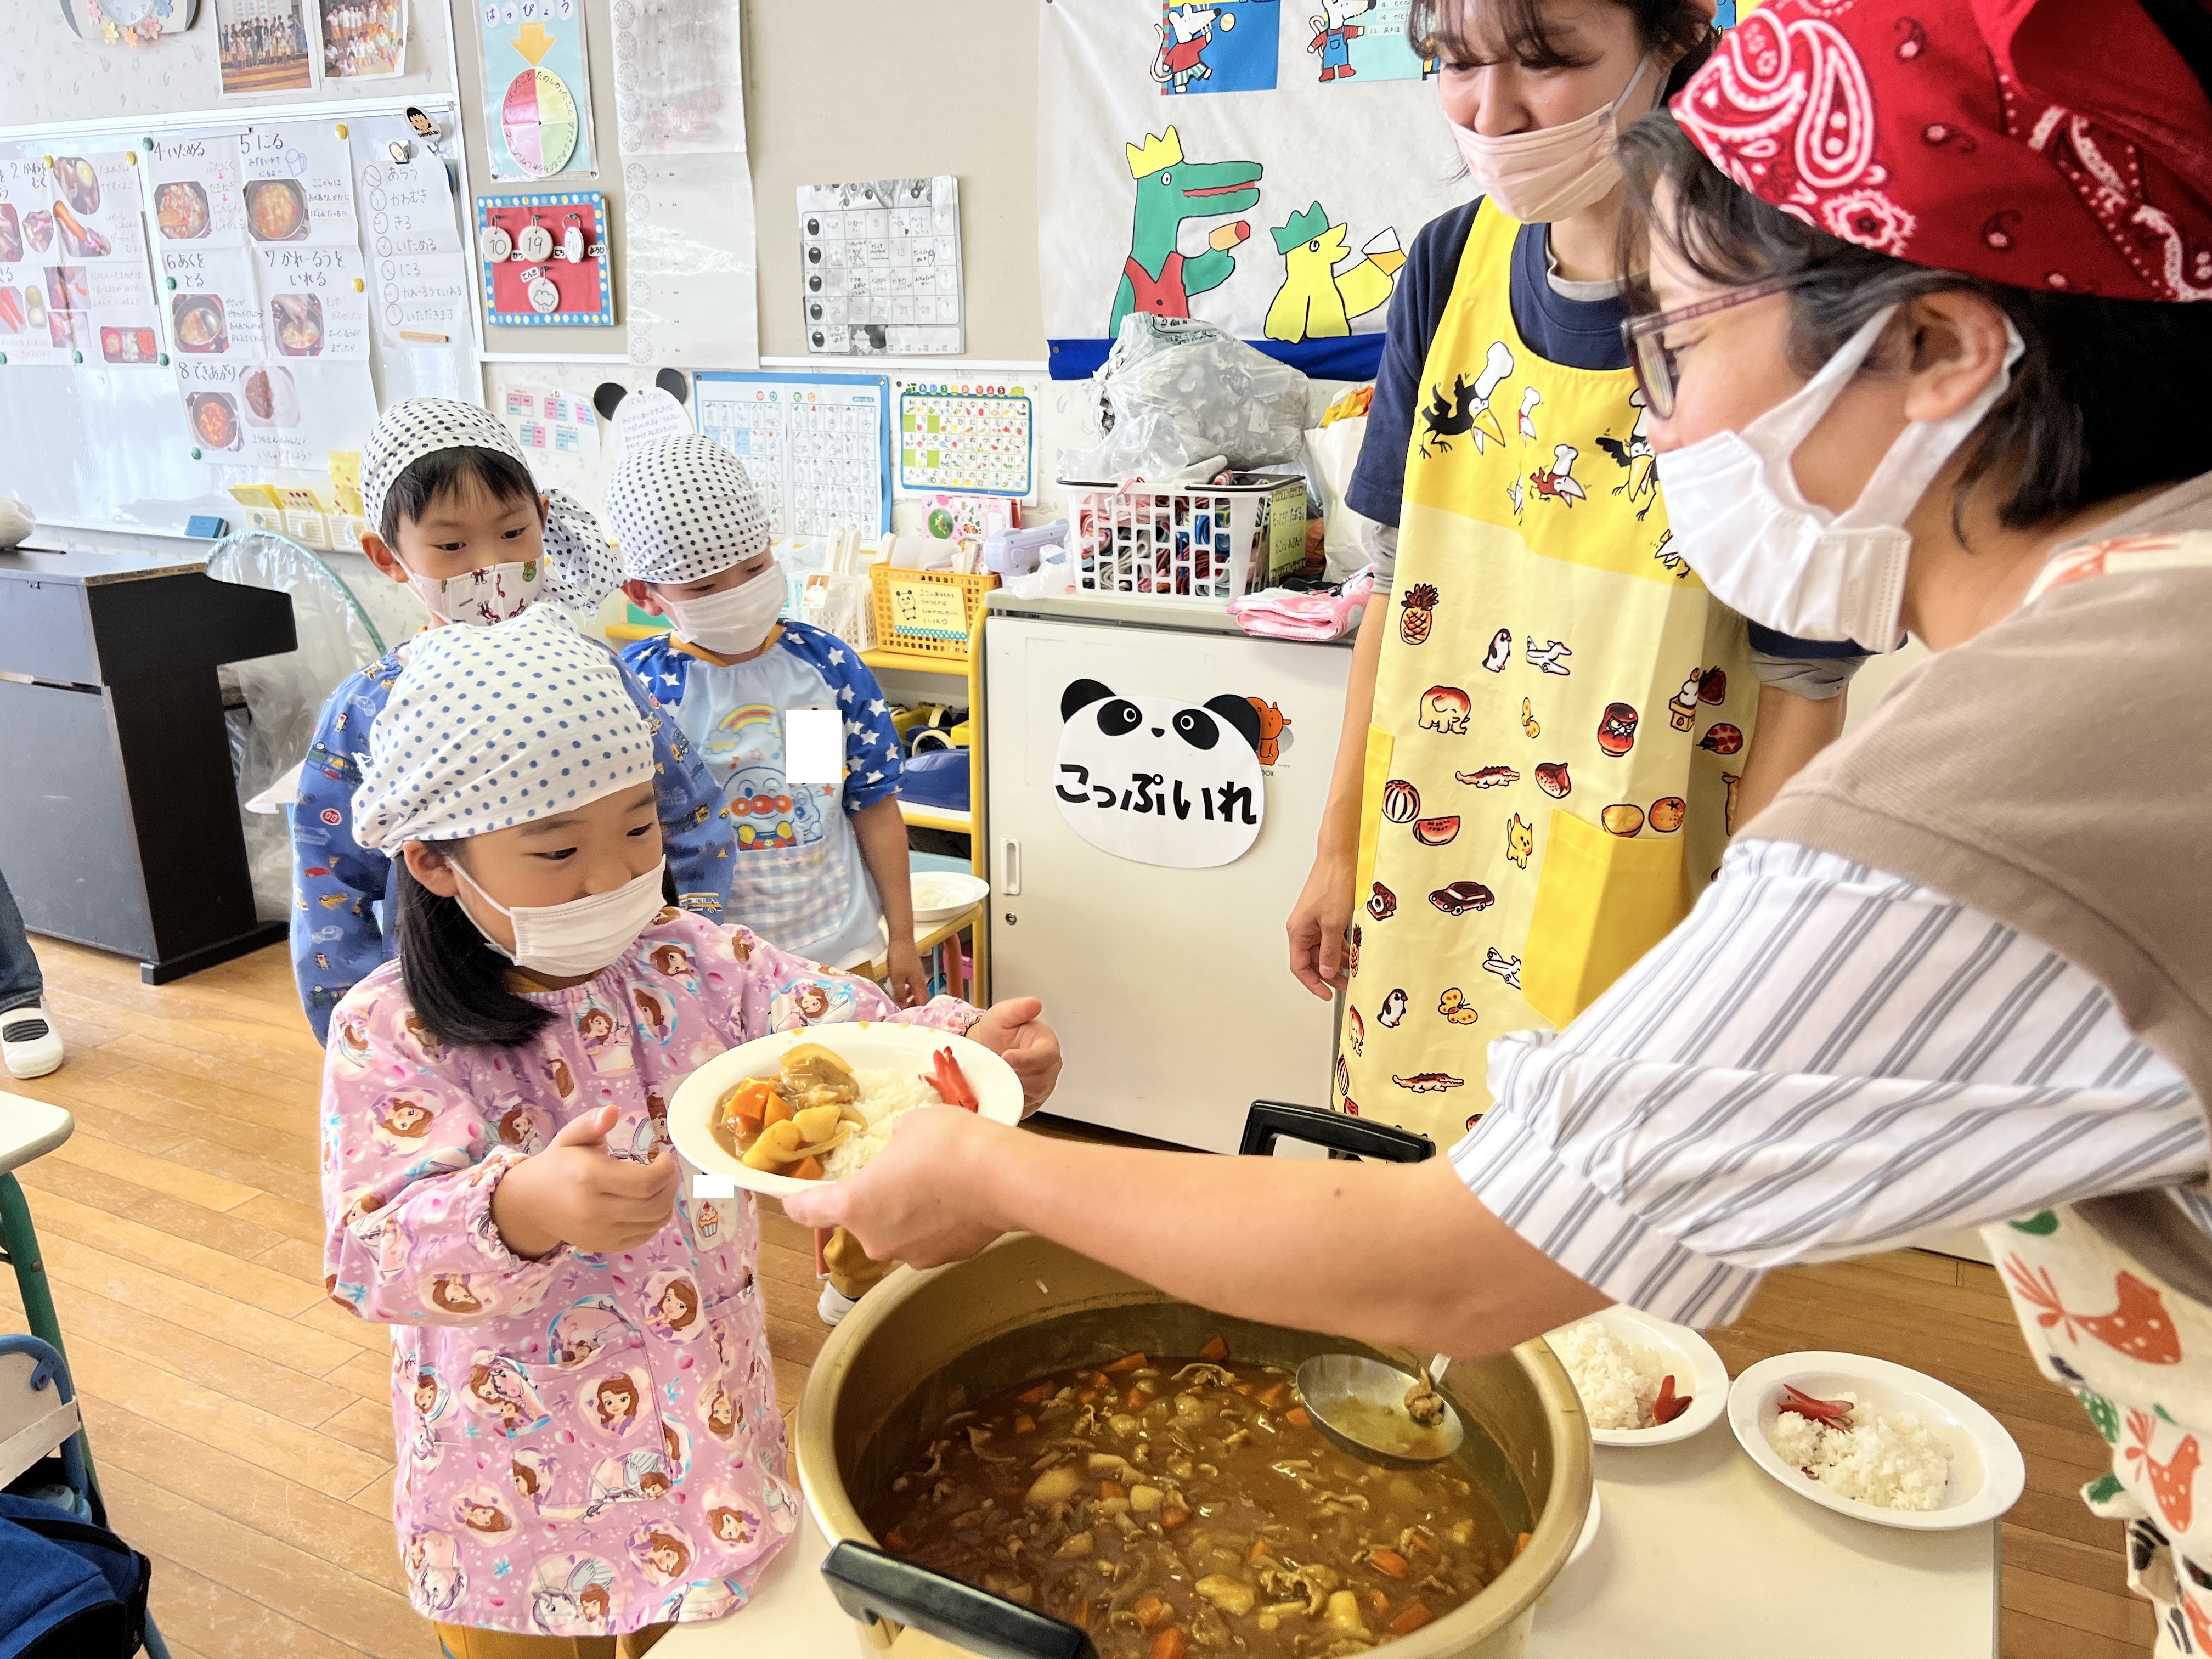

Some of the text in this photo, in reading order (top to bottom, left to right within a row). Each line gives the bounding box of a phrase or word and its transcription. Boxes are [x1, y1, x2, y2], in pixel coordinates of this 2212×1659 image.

[154, 141, 205, 162] 4 いためる
[240, 133, 284, 154] 5 にる
[10, 162, 21, 178] 2
[387, 163, 418, 182] あらう
[31, 177, 47, 189] むく
[390, 188, 427, 207] かわむき
[394, 215, 412, 230] きる
[396, 238, 437, 252] いためる
[489, 238, 507, 256] 10
[527, 236, 544, 255] 19
[554, 249, 566, 257] にち
[166, 252, 206, 269] 6 あくを
[264, 250, 275, 268] 7
[400, 262, 421, 277] にる
[522, 268, 539, 281] てんき
[185, 273, 204, 287] とる
[290, 272, 326, 287] いれる
[877, 306, 886, 315] 26
[899, 306, 909, 315] 27
[921, 306, 930, 314] 28
[178, 360, 236, 382] 8 できあがり
[1055, 763, 1257, 825] こっぷいれ
